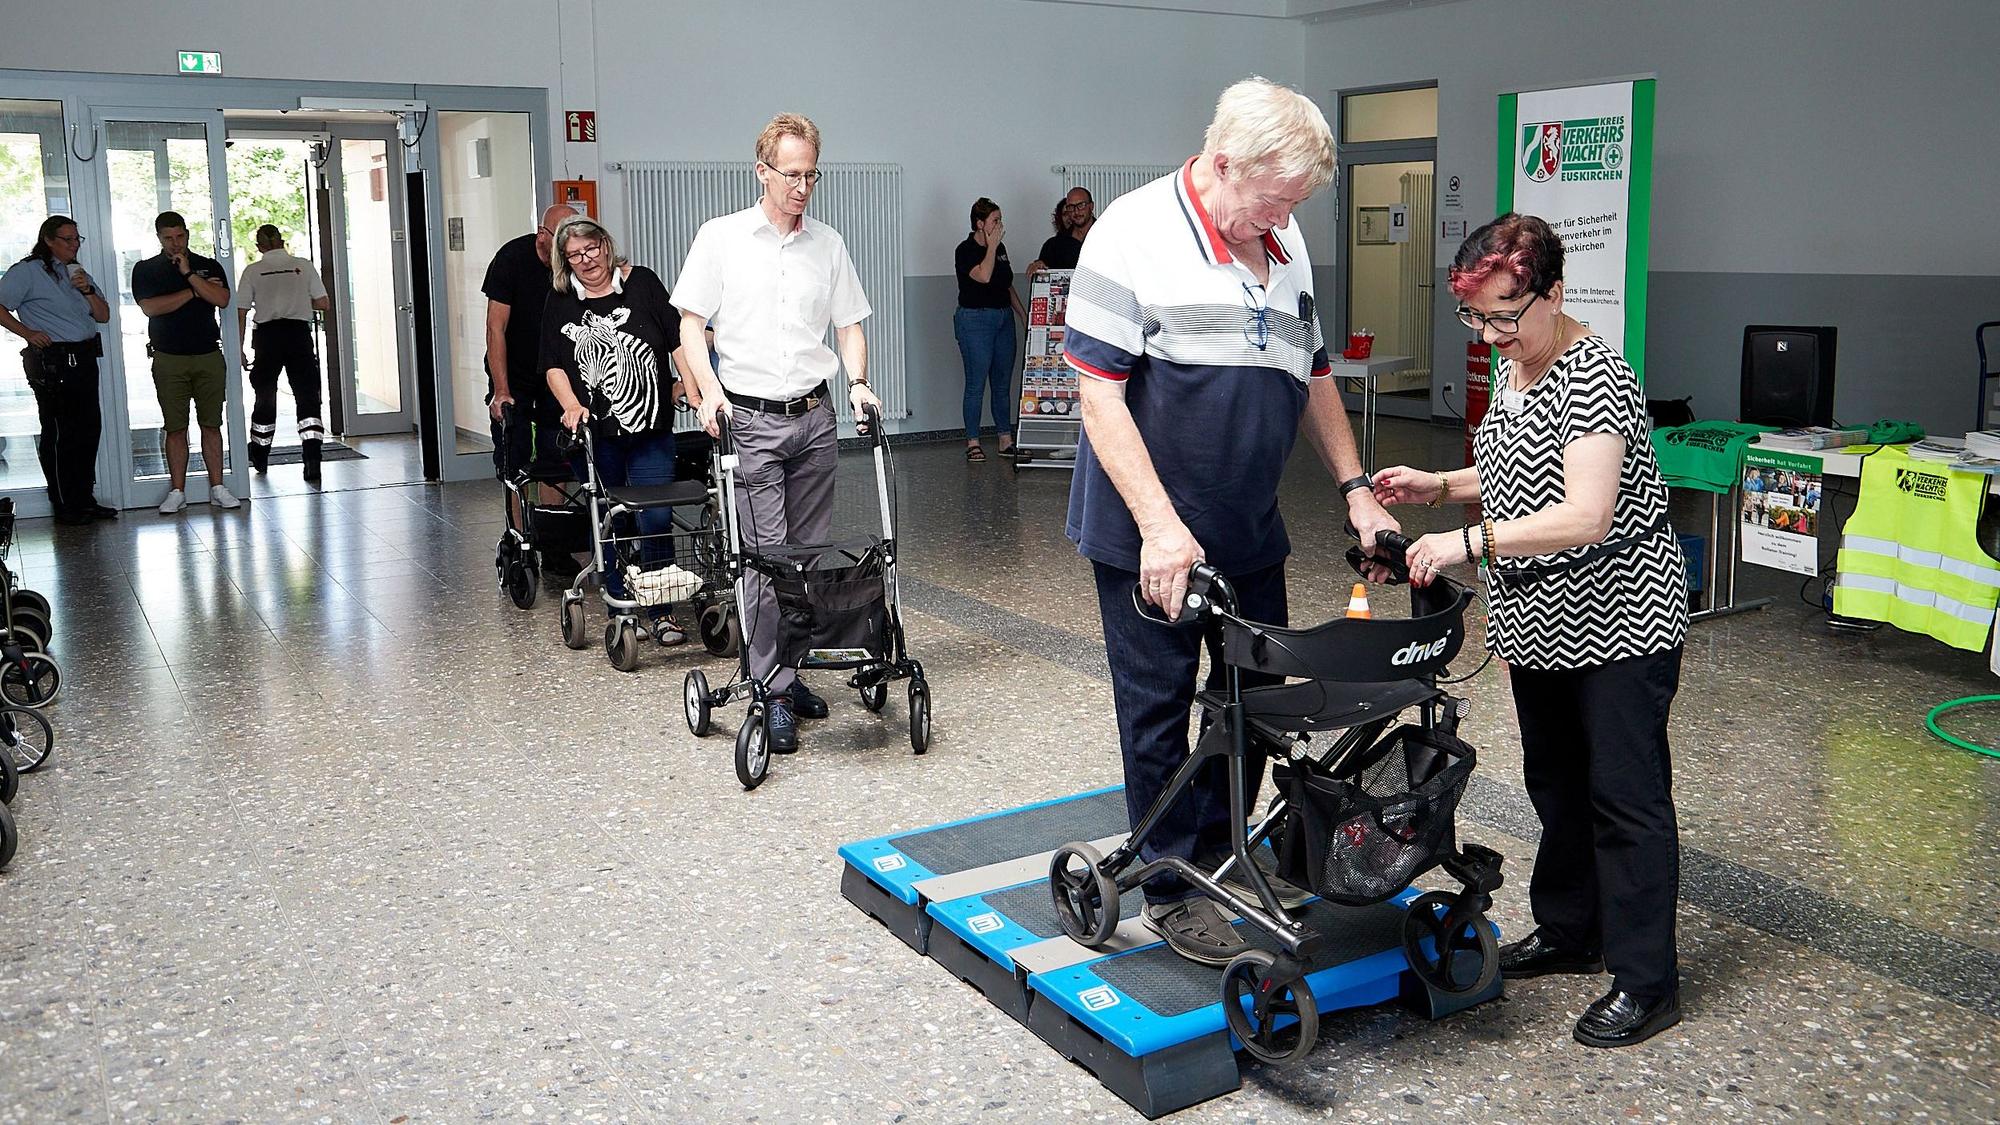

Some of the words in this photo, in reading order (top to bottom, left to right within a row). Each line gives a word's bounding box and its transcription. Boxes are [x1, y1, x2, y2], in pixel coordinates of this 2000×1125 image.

[1600, 116, 1624, 126] KREIS
[1563, 125, 1624, 145] VERKEHRS
[1562, 144, 1605, 162] WACHT
[1561, 170, 1622, 182] EUSKIRCHEN
[1564, 218, 1575, 228] für
[1577, 212, 1618, 226] Sicherheit
[1602, 226, 1612, 236] im
[1563, 242, 1605, 254] uskirchen
[1746, 454, 1776, 464] Sicherheit
[1788, 460, 1812, 470] Vorfahrt
[1391, 636, 1448, 666] drive
